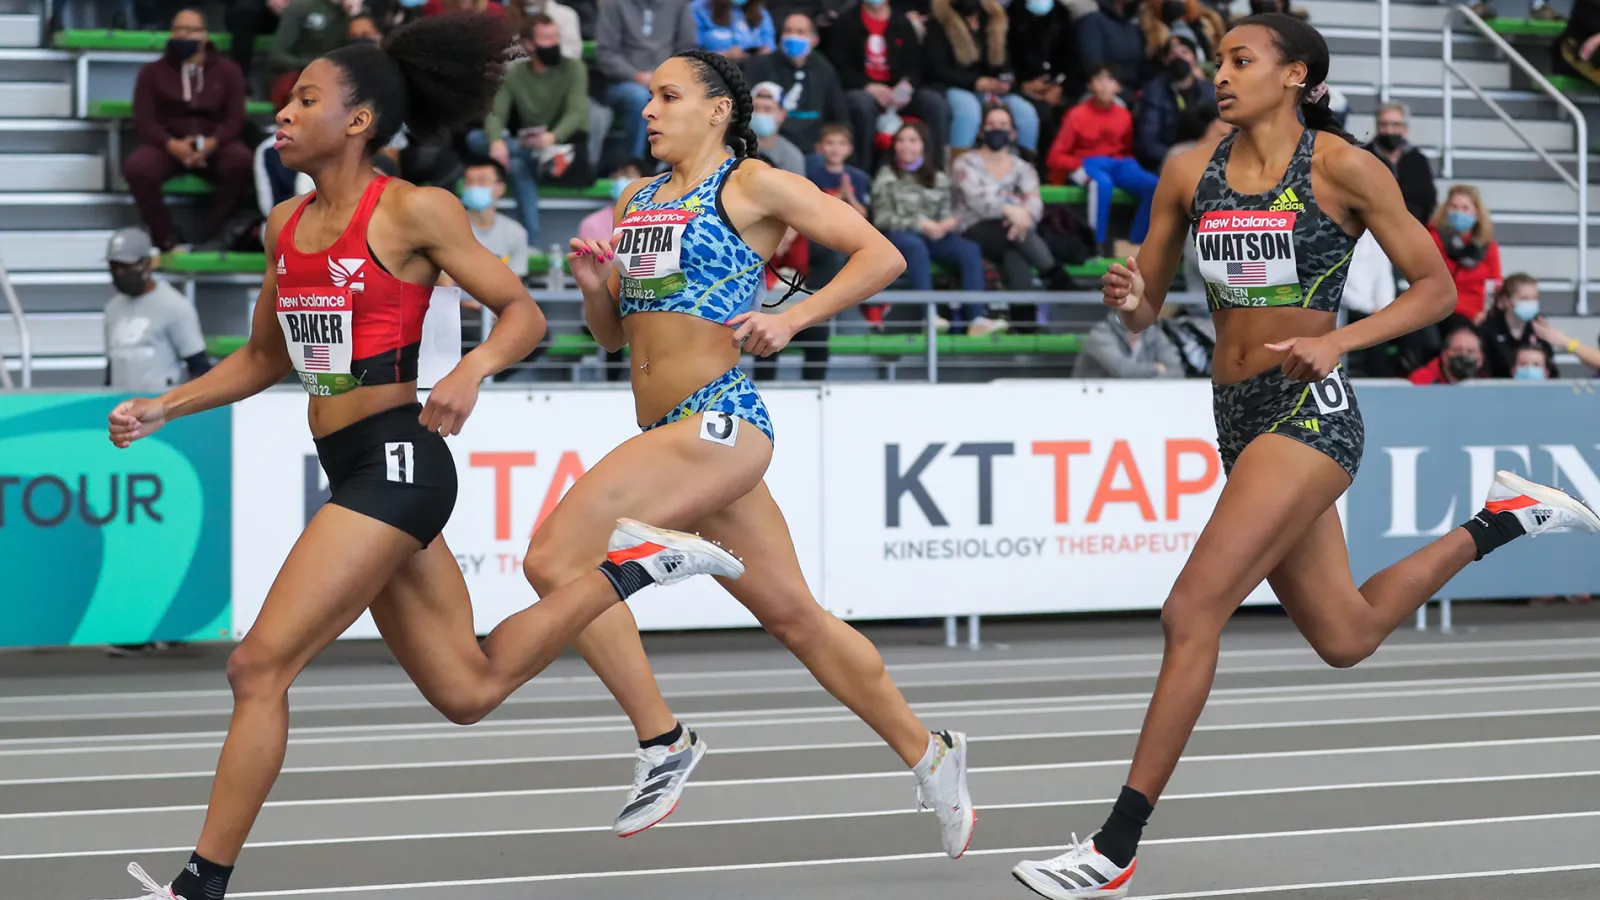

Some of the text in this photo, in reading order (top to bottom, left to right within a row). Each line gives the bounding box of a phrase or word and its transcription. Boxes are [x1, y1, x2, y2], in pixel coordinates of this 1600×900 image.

[642, 212, 685, 222] balance
[1269, 201, 1305, 212] adidas
[1204, 216, 1287, 229] new balance
[617, 226, 674, 255] DETRA
[1199, 232, 1292, 261] WATSON
[279, 293, 345, 308] new balance
[644, 289, 656, 300] 22
[1251, 297, 1267, 307] 22
[285, 313, 343, 344] BAKER
[319, 385, 332, 396] 22
[1314, 378, 1343, 408] 6
[707, 412, 733, 440] 3
[390, 444, 407, 483] 1
[884, 438, 1220, 528] KT TAP
[0, 473, 164, 528] TOUR
[883, 536, 1047, 561] KINESIOLOGY
